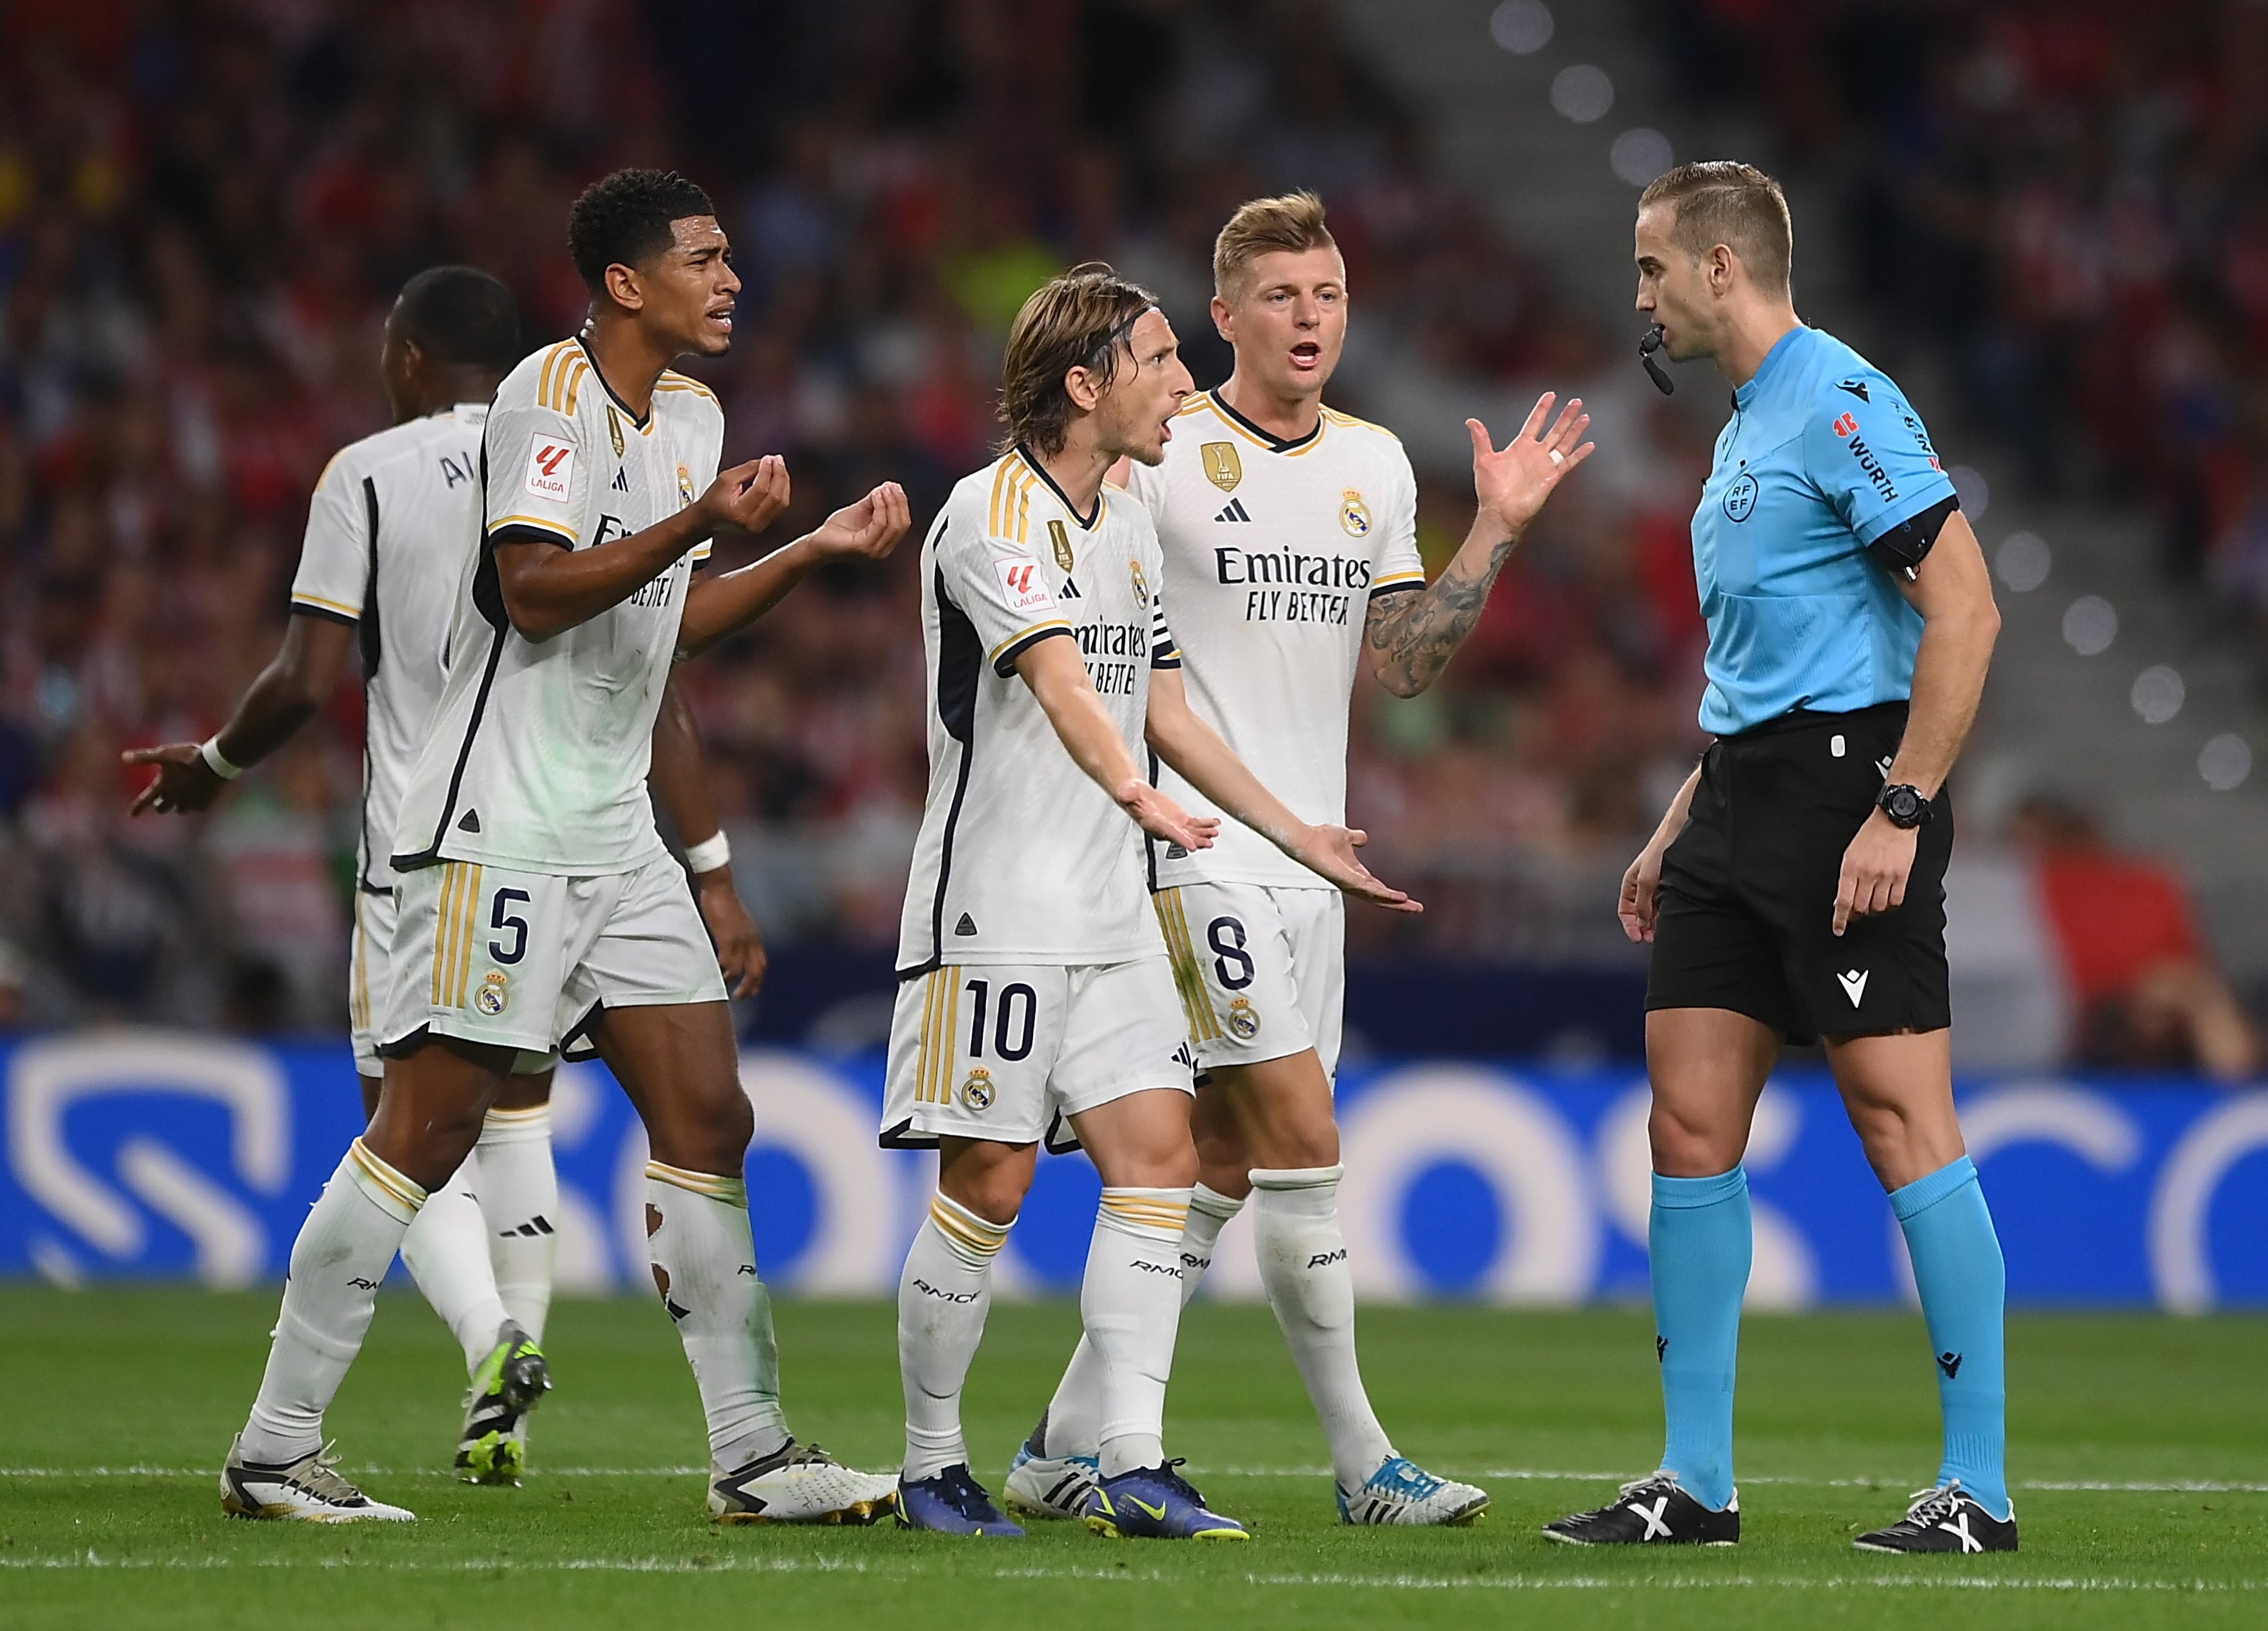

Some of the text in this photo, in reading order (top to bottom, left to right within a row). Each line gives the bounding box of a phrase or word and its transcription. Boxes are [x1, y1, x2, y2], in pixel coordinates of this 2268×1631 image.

[531, 478, 564, 494] LALIGA
[1732, 485, 1752, 497] RF
[1729, 499, 1748, 510] EF
[1214, 545, 1371, 589] Emirates
[1013, 593, 1048, 608] LALIGA
[1246, 591, 1349, 625] FLY BETTER
[1074, 614, 1146, 658] mirates
[488, 887, 531, 965] 5
[1207, 917, 1256, 990] 8
[964, 979, 1037, 1062] 10
[1307, 1248, 1347, 1269] RM
